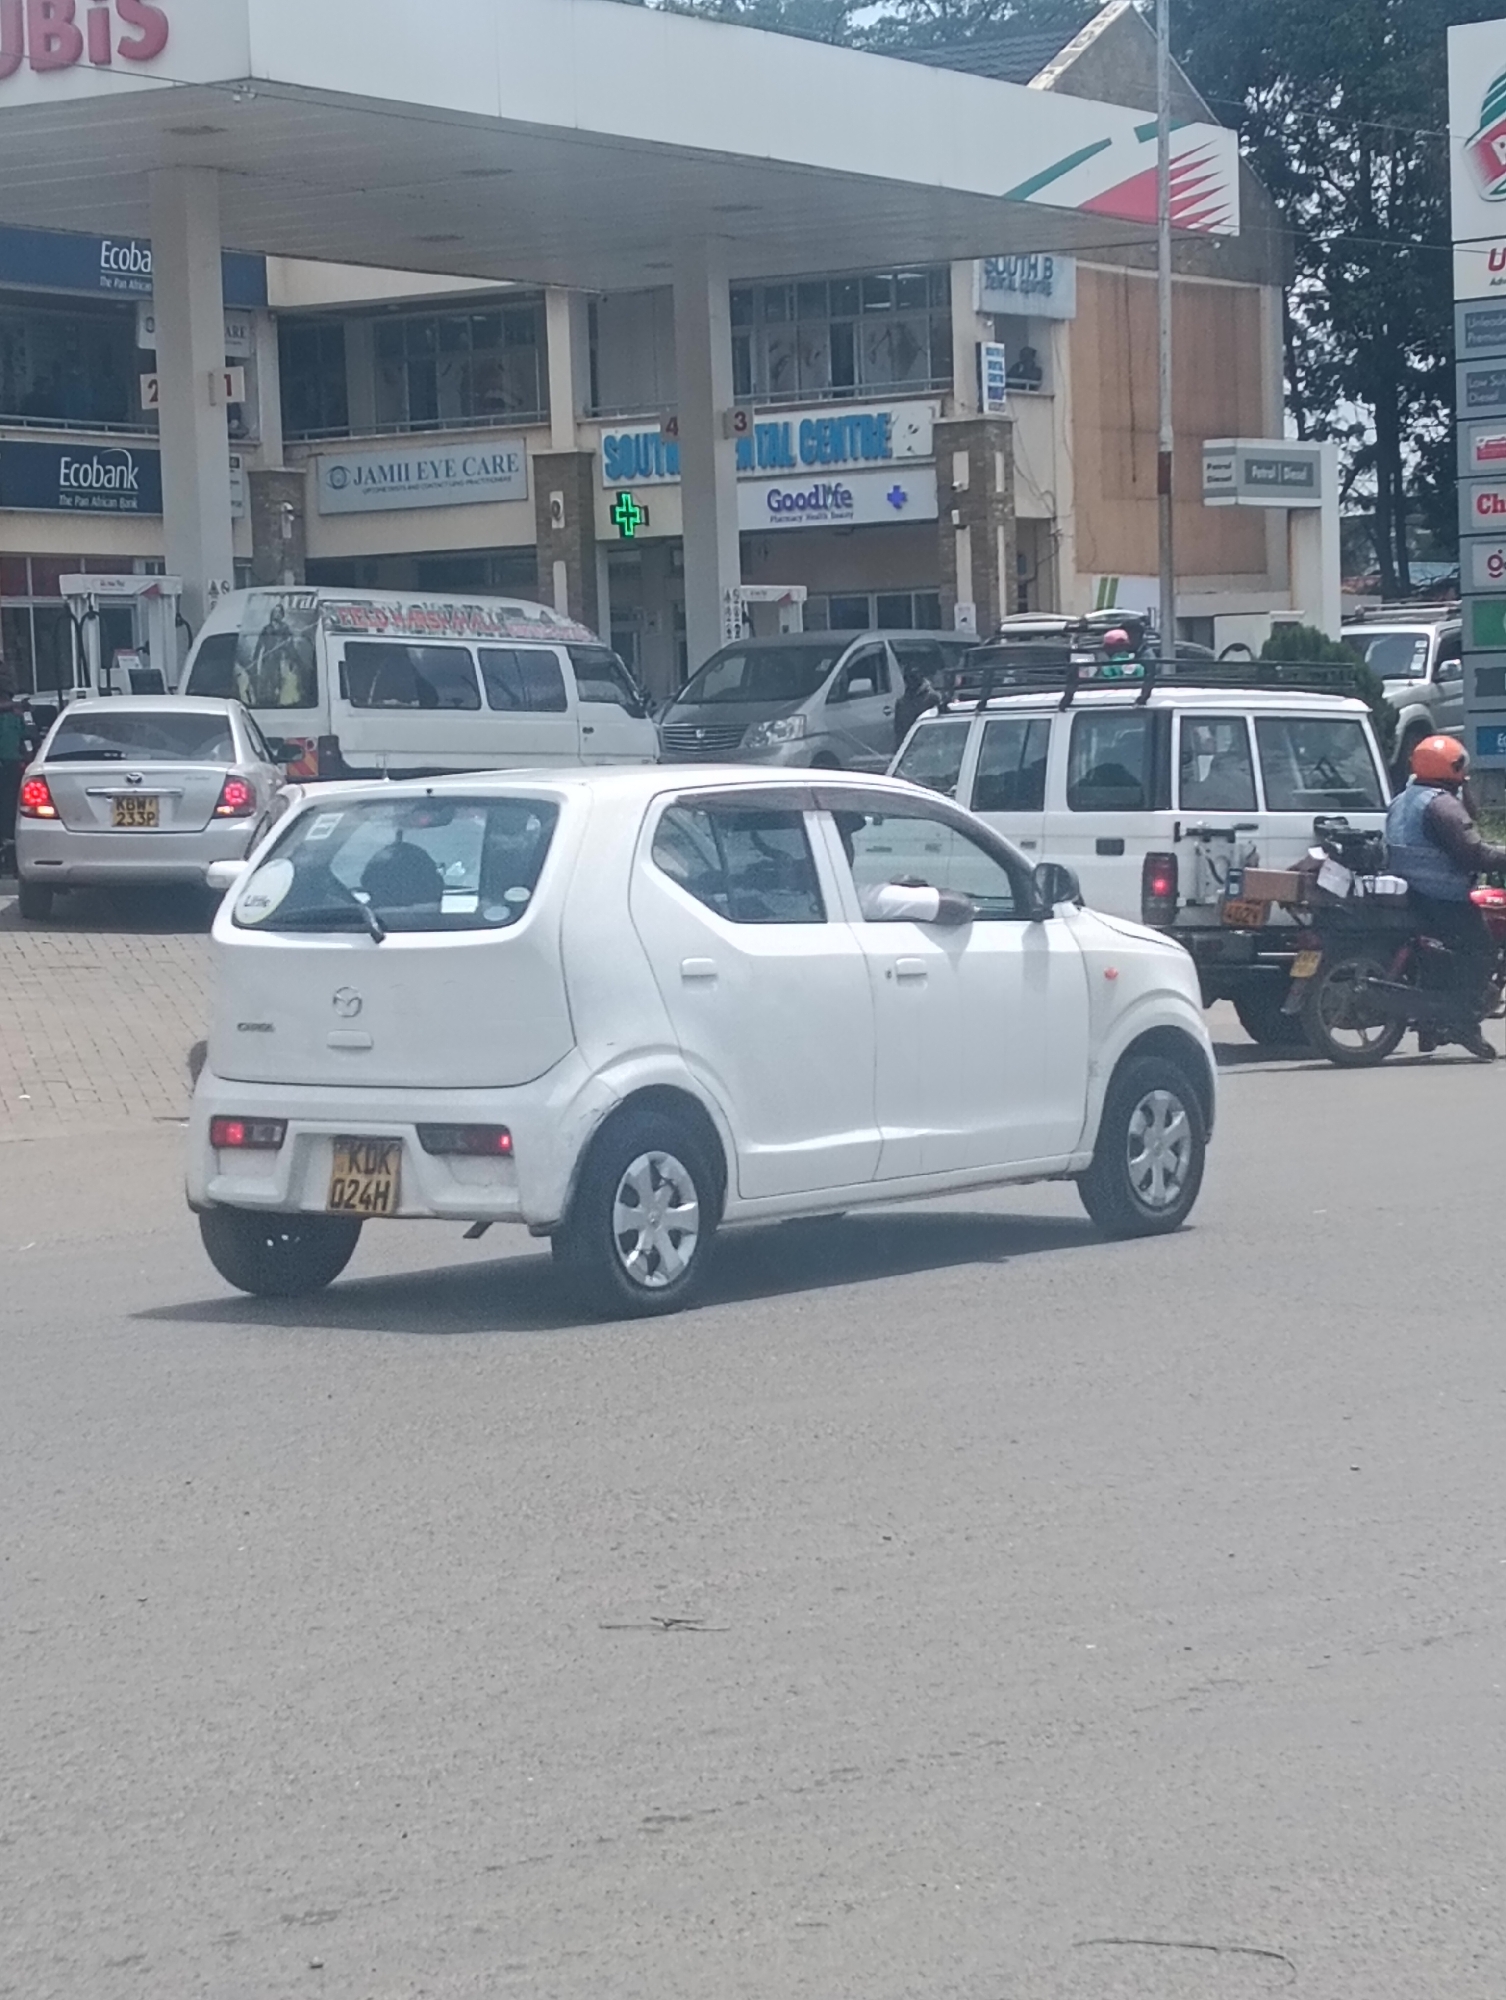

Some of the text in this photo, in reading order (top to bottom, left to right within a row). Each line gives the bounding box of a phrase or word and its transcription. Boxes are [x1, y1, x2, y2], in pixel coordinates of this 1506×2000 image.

[1043, 256, 1054, 280] B
[148, 379, 159, 403] 2
[224, 374, 233, 397] 1
[665, 415, 680, 436] 4
[733, 410, 748, 432] 3
[799, 411, 893, 466] CENTRE
[59, 449, 139, 490] Ecobank
[353, 452, 520, 486] JAMII EYE CARE
[59, 494, 138, 509] The Pan African Bank
[766, 481, 854, 513] Goodlife
[116, 798, 146, 812] KBW
[116, 812, 156, 826] 233P
[348, 1142, 393, 1175] KDK
[330, 1178, 392, 1212] 024H
